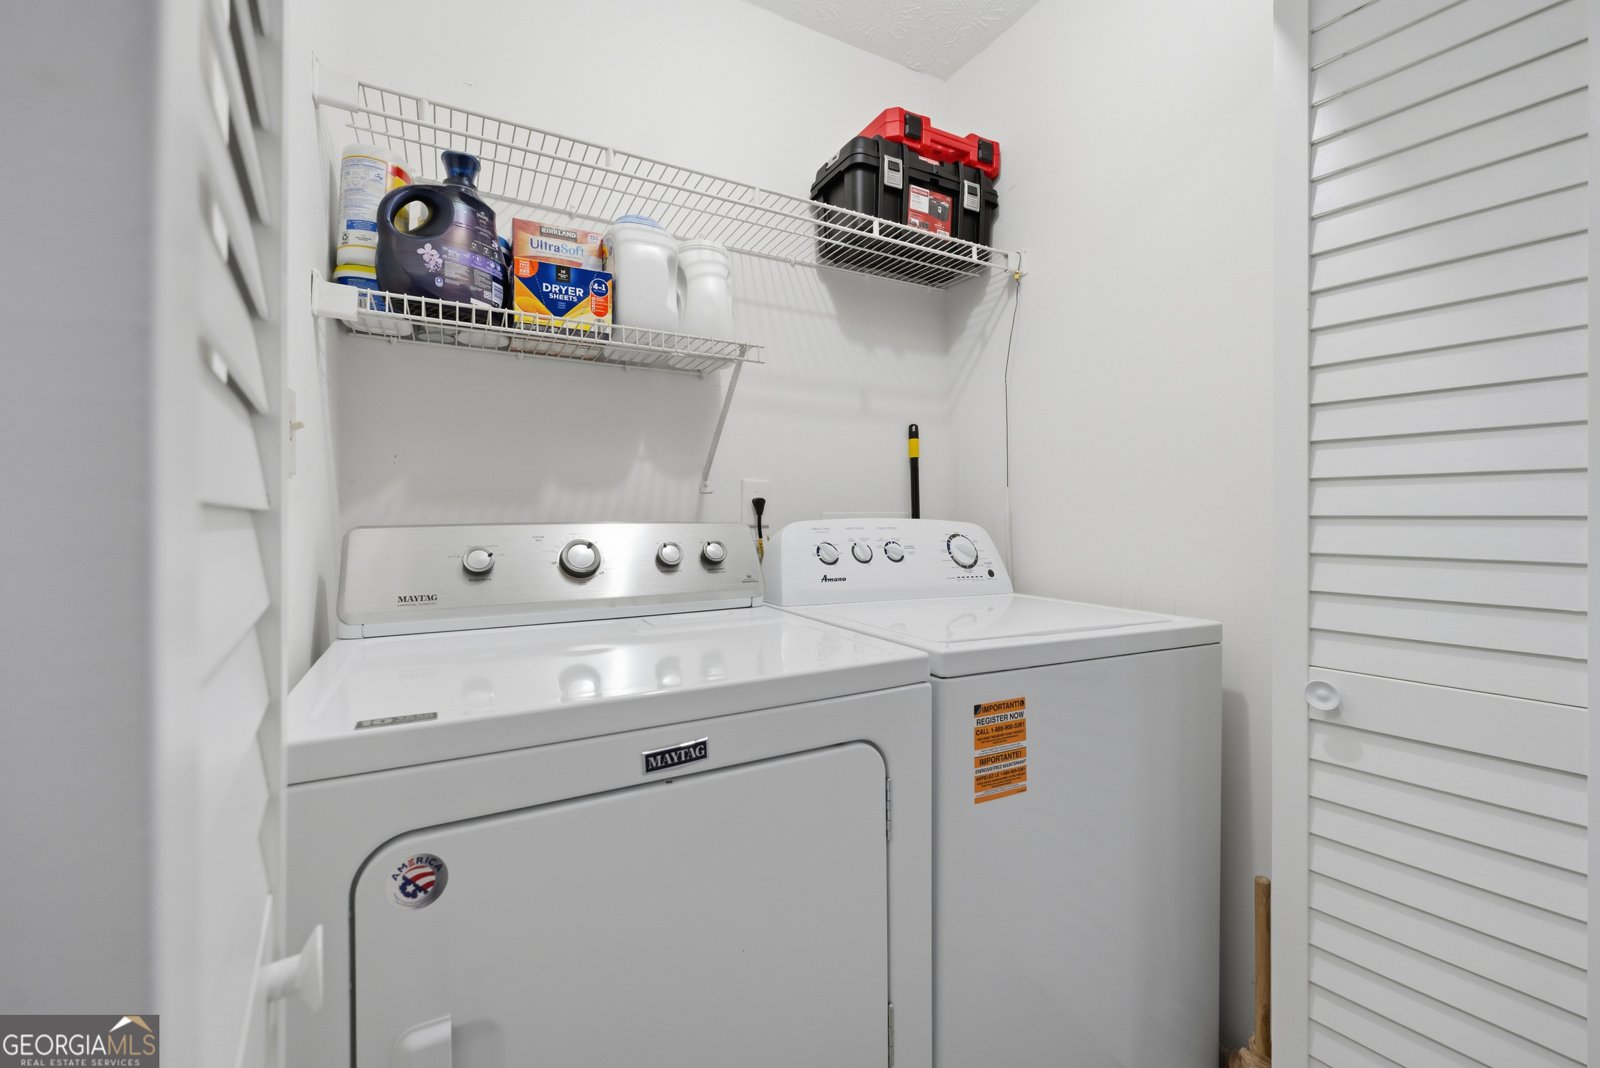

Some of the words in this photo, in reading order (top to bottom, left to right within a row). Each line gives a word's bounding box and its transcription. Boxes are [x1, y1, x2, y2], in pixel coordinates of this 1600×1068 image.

[541, 226, 577, 239] KIRKLAND
[530, 238, 585, 257] UltraSoft
[542, 283, 584, 297] DRYER
[549, 292, 578, 302] SHEETS
[821, 574, 847, 583] Amana
[397, 594, 438, 603] MAYTAG
[976, 713, 1009, 727] REGISTER
[1009, 711, 1025, 720] NOW
[647, 744, 705, 769] MAYTAG
[979, 750, 1022, 766] IMPORTANTE!
[391, 856, 444, 882] AMERICA
